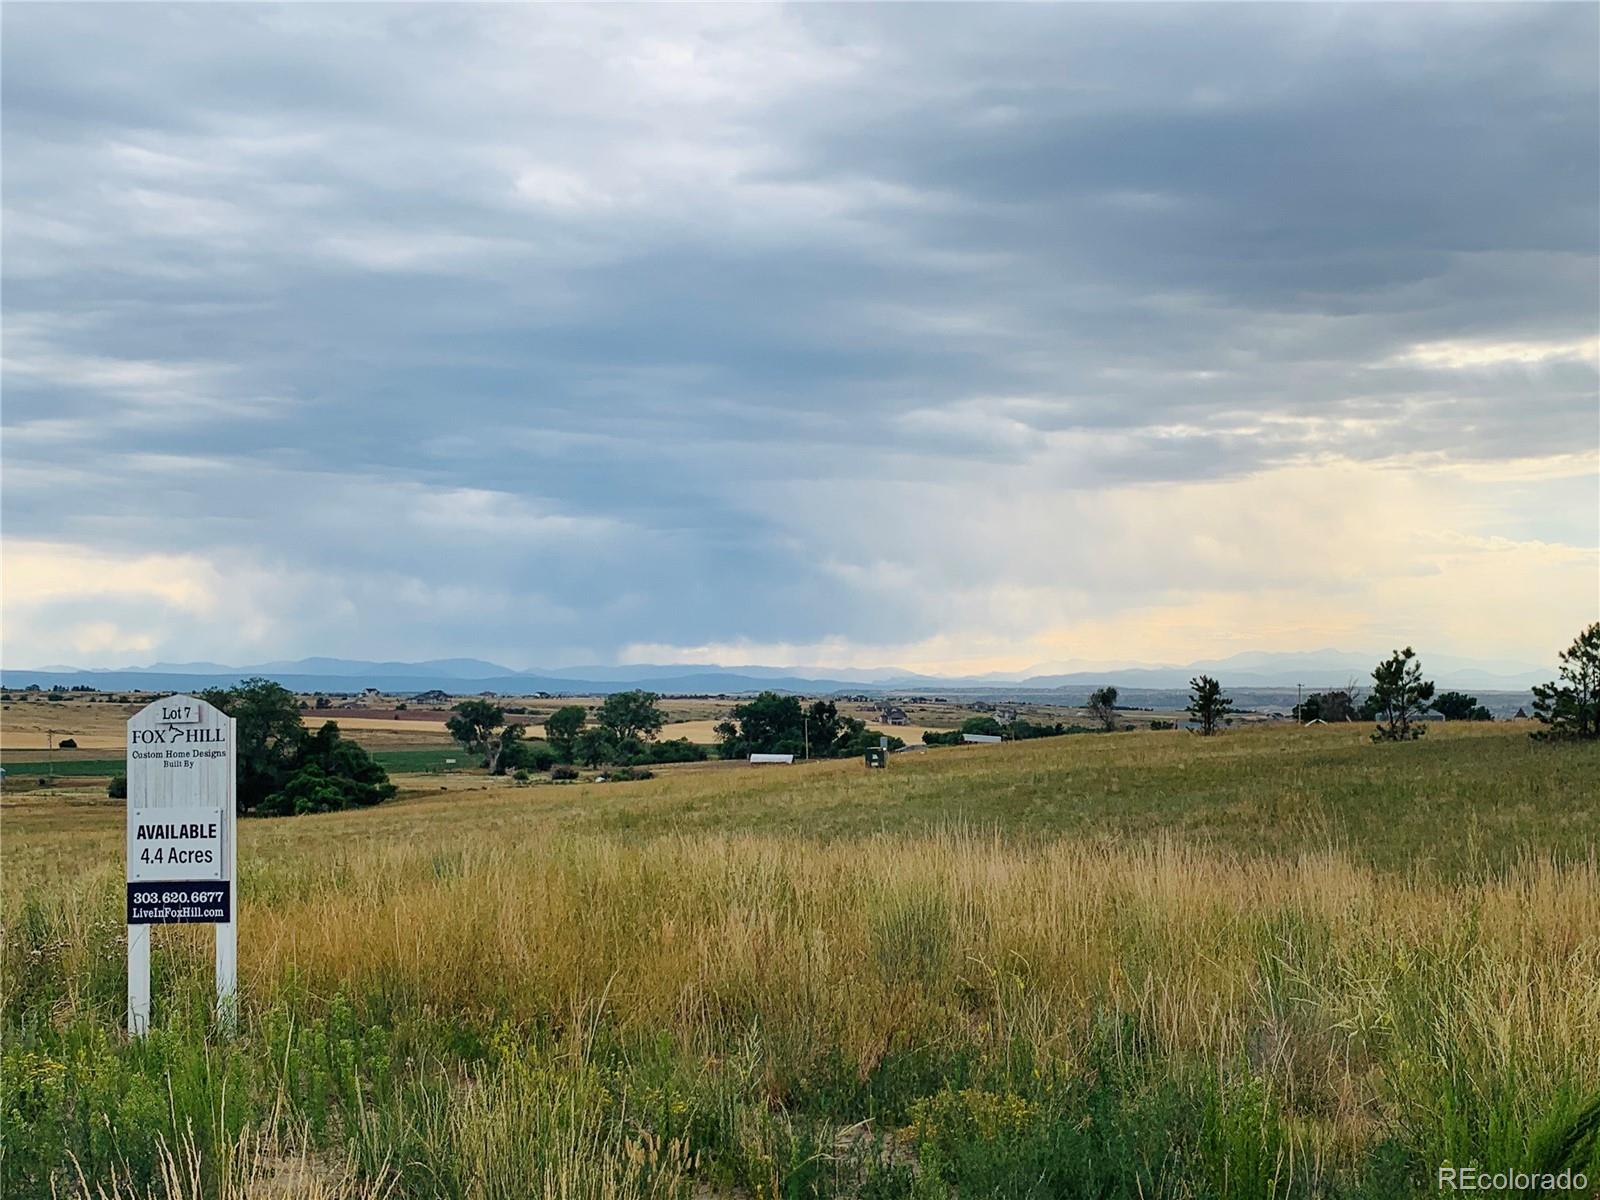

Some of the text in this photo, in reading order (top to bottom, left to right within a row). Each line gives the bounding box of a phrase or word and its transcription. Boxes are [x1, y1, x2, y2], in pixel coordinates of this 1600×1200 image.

[162, 707, 191, 720] Lot 7
[132, 729, 225, 744] FOX HILL
[132, 749, 226, 759] Custom Home Designs
[163, 760, 194, 769] Built By
[136, 823, 217, 840] AVAILABLE
[140, 847, 213, 865] 4.4 Acres
[133, 891, 224, 904] 303.620.6677
[132, 906, 224, 919] LiveInFoxHill.com
